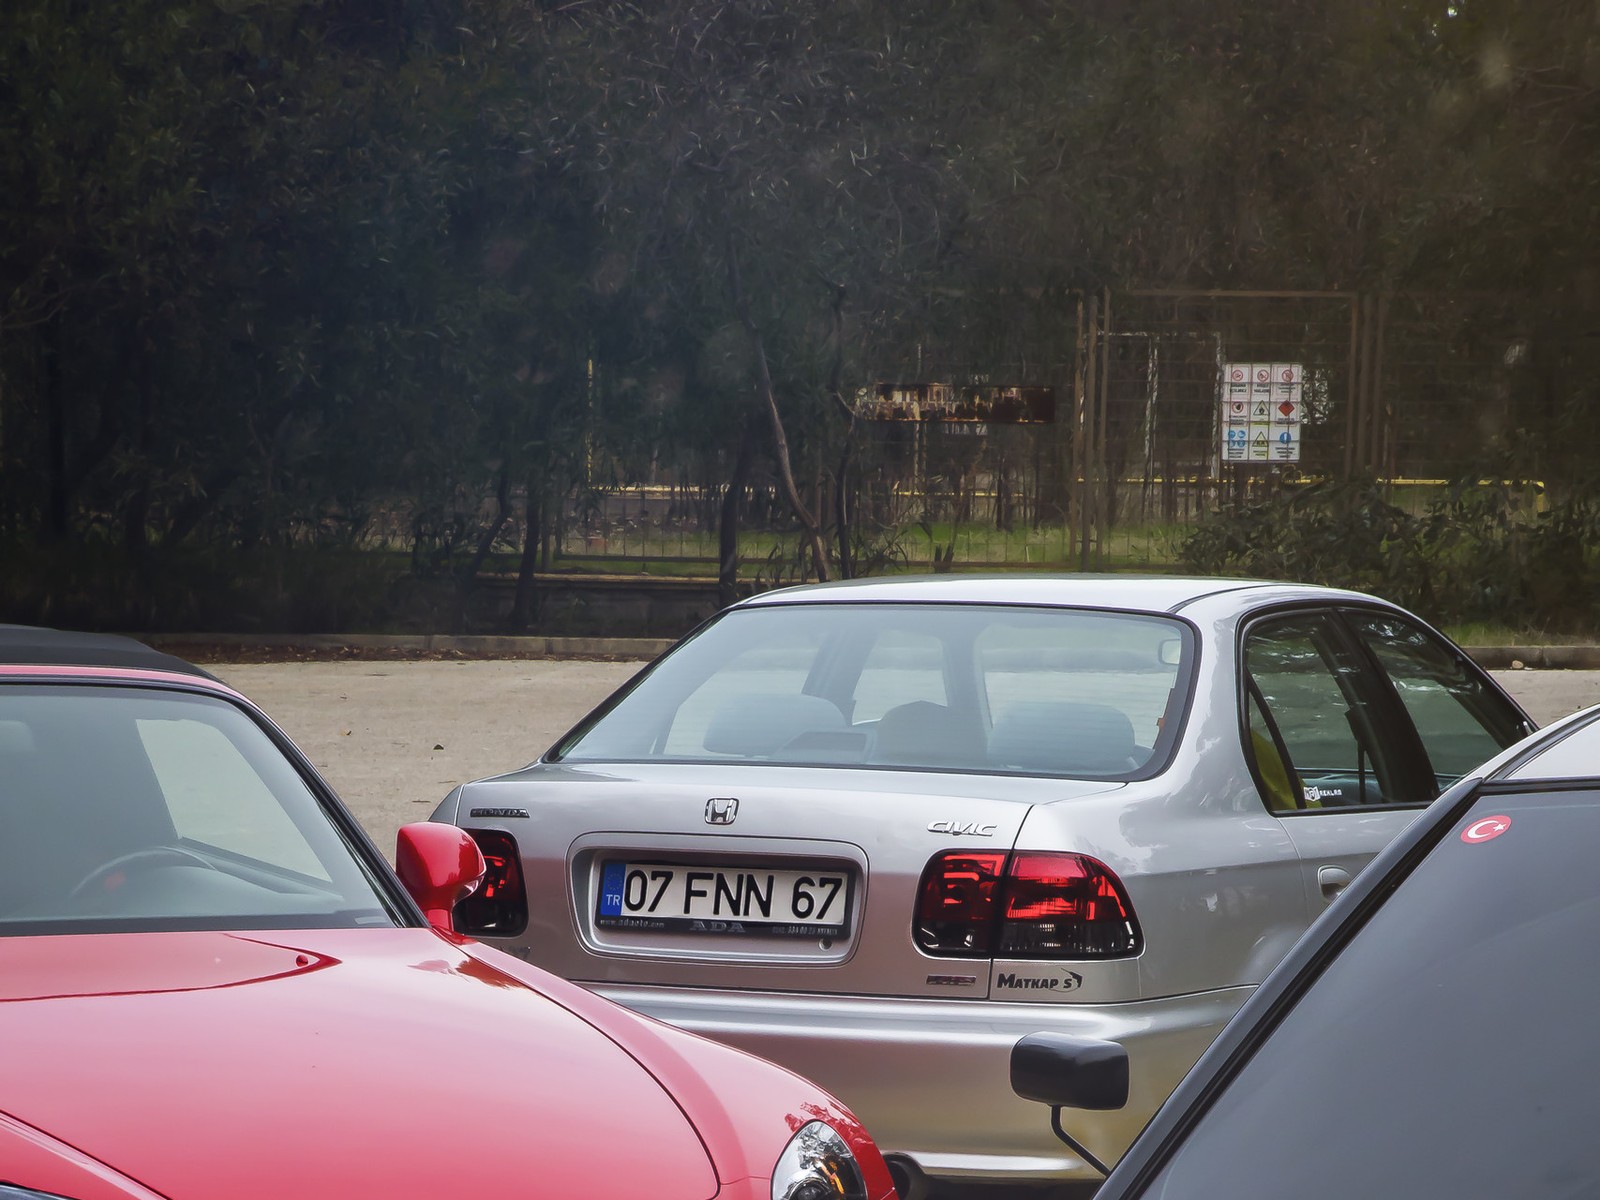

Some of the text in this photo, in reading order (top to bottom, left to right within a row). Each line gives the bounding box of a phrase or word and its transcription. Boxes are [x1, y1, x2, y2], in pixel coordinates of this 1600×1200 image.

[926, 821, 998, 838] CIVIC
[606, 894, 621, 906] TR
[624, 869, 843, 919] 07 FNN 67
[689, 920, 747, 933] ADA
